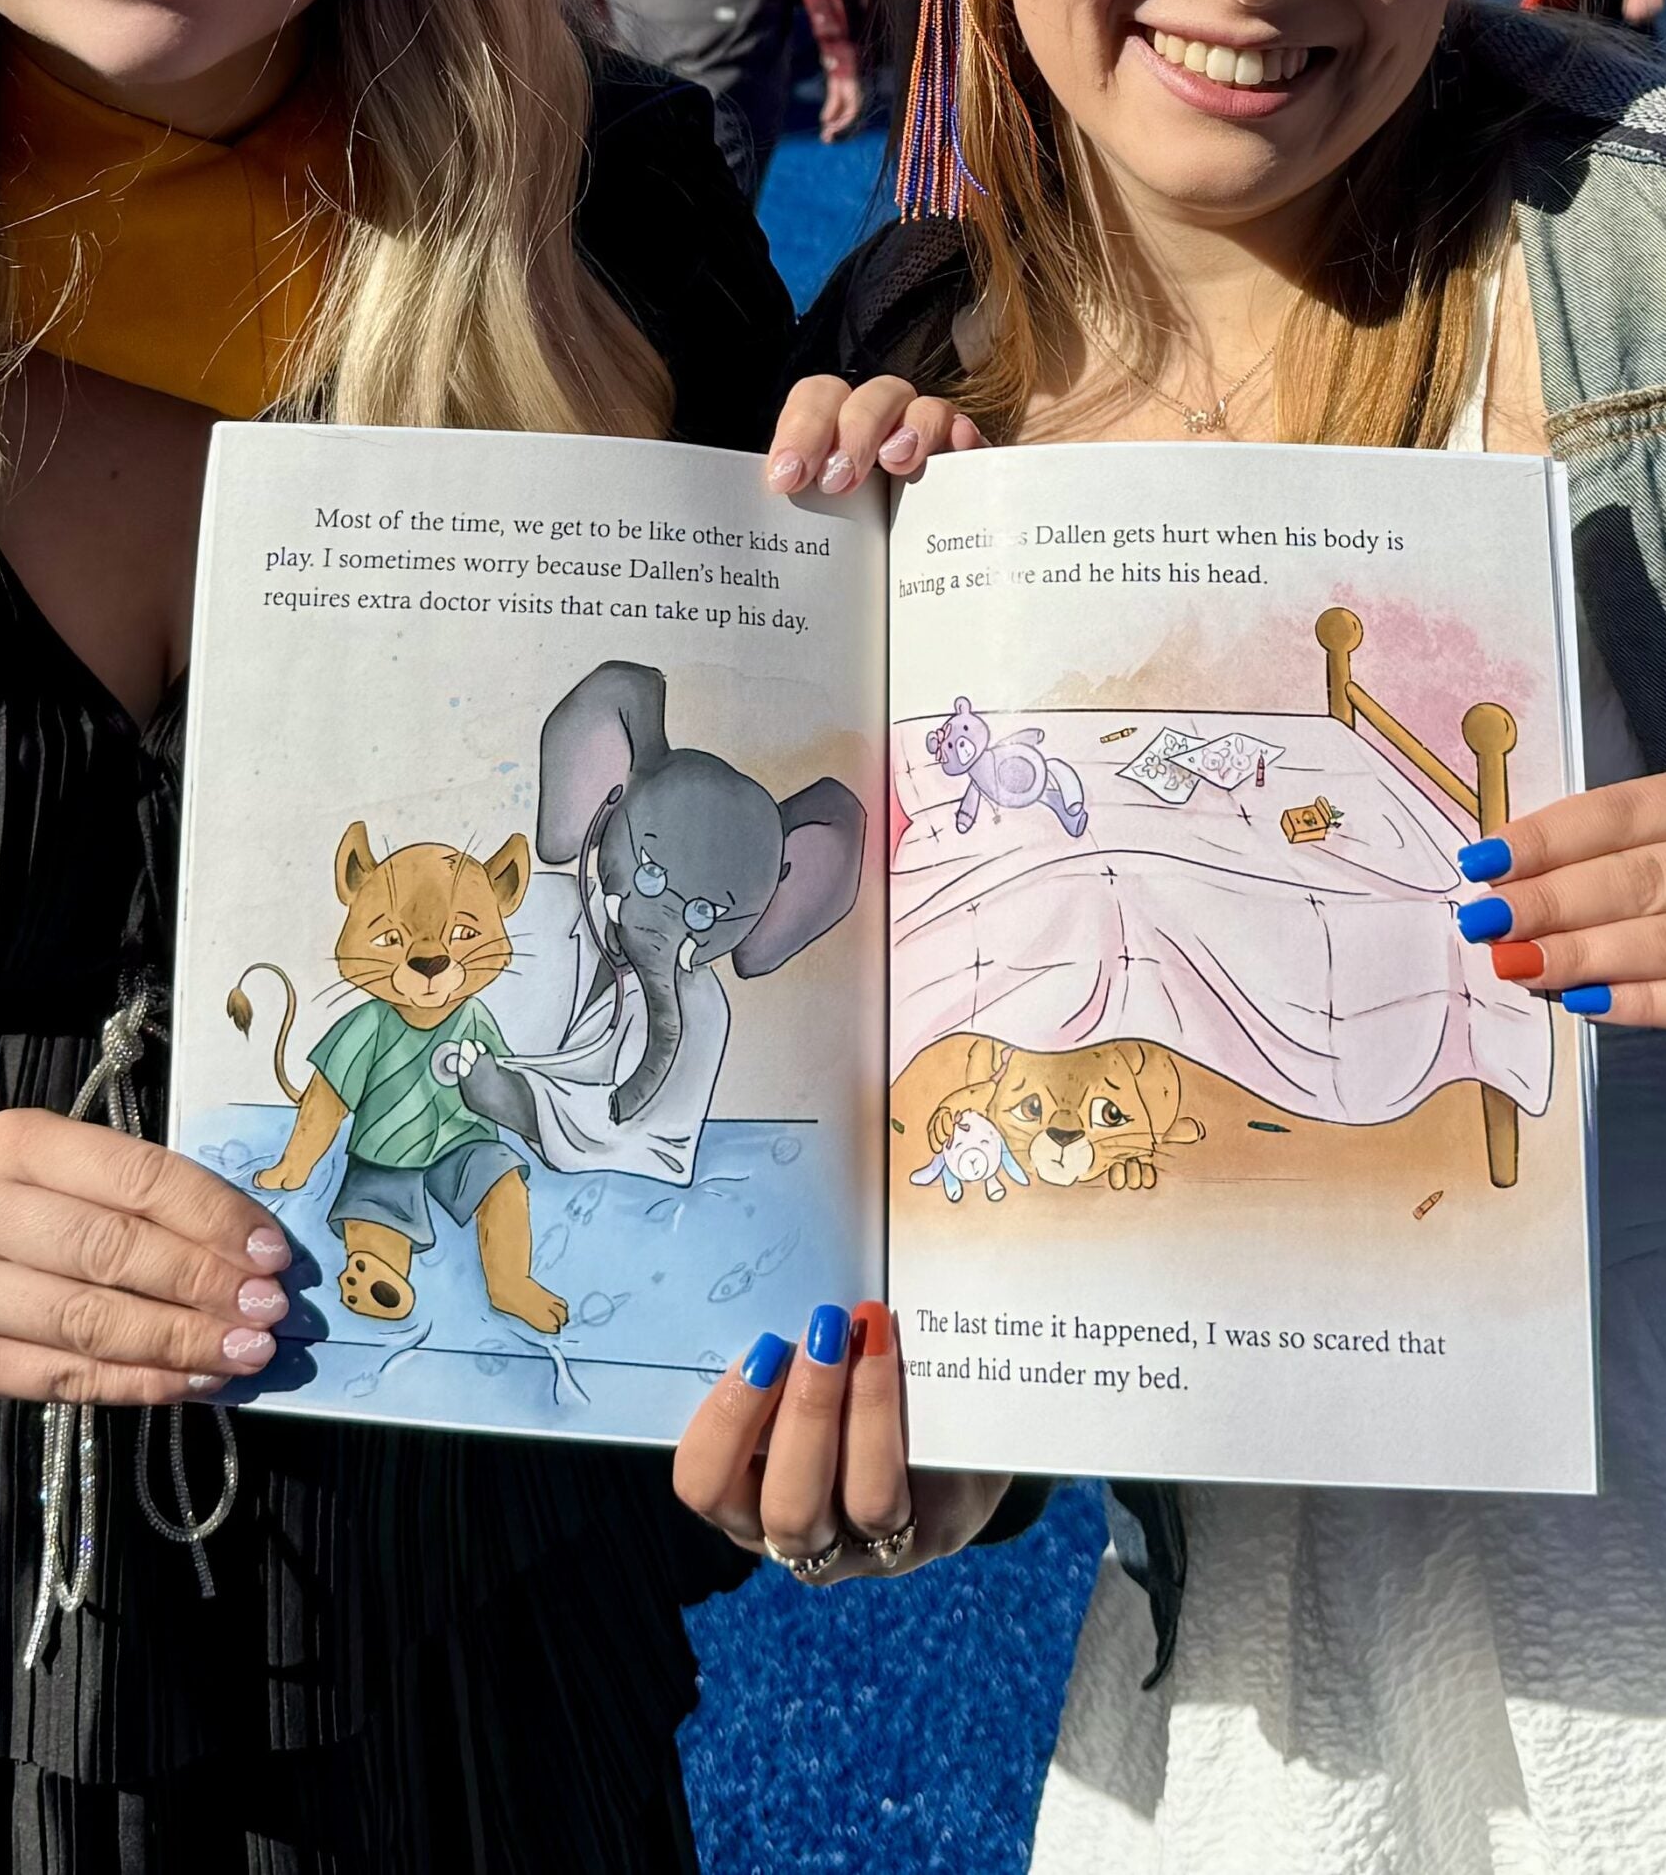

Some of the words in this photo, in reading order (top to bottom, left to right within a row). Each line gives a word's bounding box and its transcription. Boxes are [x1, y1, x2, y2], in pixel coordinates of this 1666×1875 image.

[314, 507, 372, 530] Most
[378, 509, 405, 531] of
[410, 510, 445, 532] the
[451, 511, 505, 538] time,
[512, 519, 545, 535] we
[549, 519, 584, 541] get
[589, 520, 611, 539] to
[617, 518, 643, 540] be
[648, 520, 687, 543] like
[692, 525, 745, 549] other
[748, 530, 789, 554] kids
[794, 537, 831, 557] and
[1035, 524, 1107, 545] Dallen
[1112, 526, 1156, 549] gets
[1162, 522, 1210, 545] hurt
[1215, 524, 1279, 546] when
[1284, 525, 1318, 548] his
[1323, 527, 1380, 555] body
[1387, 529, 1405, 551] is
[265, 545, 315, 573] play.
[322, 547, 334, 568] I
[338, 546, 456, 572] sometimes
[463, 557, 530, 579] worry
[536, 553, 622, 578] because
[628, 555, 714, 584] Dallen's
[719, 564, 781, 590] health
[898, 572, 946, 599] having
[949, 574, 960, 590] a
[1041, 562, 1082, 584] and
[1088, 562, 1115, 583] he
[1121, 561, 1162, 583] hits
[1167, 561, 1201, 584] his
[1207, 562, 1269, 585] head.
[262, 586, 351, 612] requires
[357, 593, 413, 610] extra
[419, 590, 492, 613] doctor
[497, 592, 554, 615] visits
[560, 594, 604, 617] that
[609, 602, 649, 619] can
[654, 599, 699, 622] take
[704, 607, 732, 629] up
[737, 604, 766, 627] his
[771, 608, 809, 636] day.
[916, 1308, 949, 1333] The
[953, 1310, 988, 1336] last
[994, 1312, 1044, 1338] time
[1050, 1314, 1067, 1339] it
[1074, 1315, 1198, 1350] happened,
[1206, 1321, 1217, 1346] I
[1224, 1329, 1271, 1348] was
[1278, 1331, 1306, 1350] so
[1312, 1329, 1391, 1353] scared
[1397, 1330, 1446, 1356] that
[936, 1356, 971, 1380] and
[977, 1356, 1012, 1382] hid
[1018, 1360, 1087, 1386] under
[1093, 1369, 1131, 1394] my
[1137, 1364, 1189, 1391] bed.
